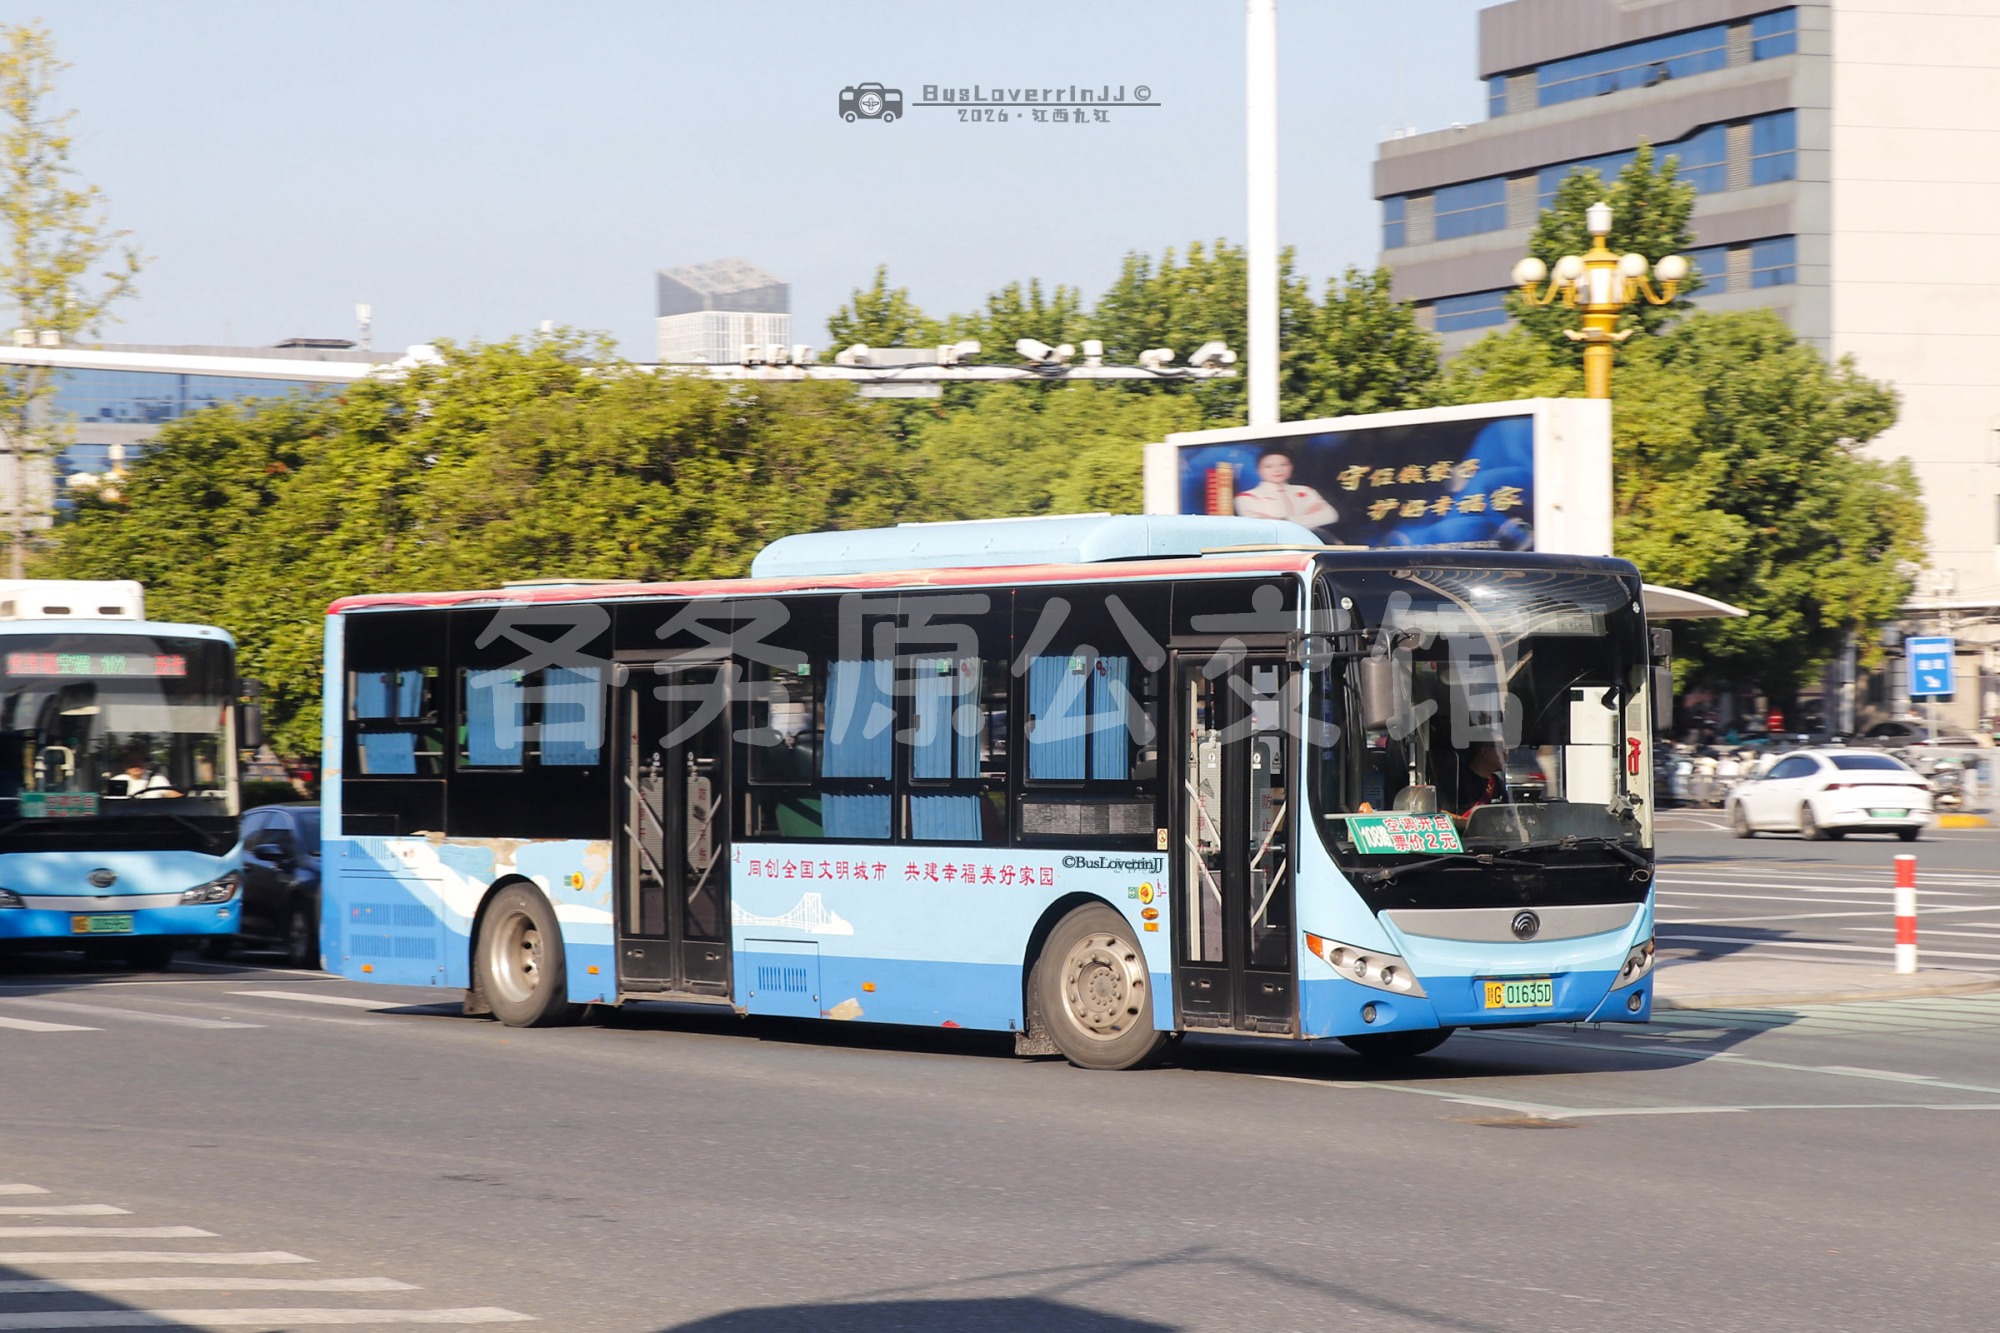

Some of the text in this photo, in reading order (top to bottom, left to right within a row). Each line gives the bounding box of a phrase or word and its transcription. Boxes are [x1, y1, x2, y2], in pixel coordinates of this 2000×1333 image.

[1383, 815, 1452, 833] 空调开启
[1391, 833, 1458, 850] 票价2元
[748, 858, 1055, 887] 同创全国文明城市 共建幸福美好家园
